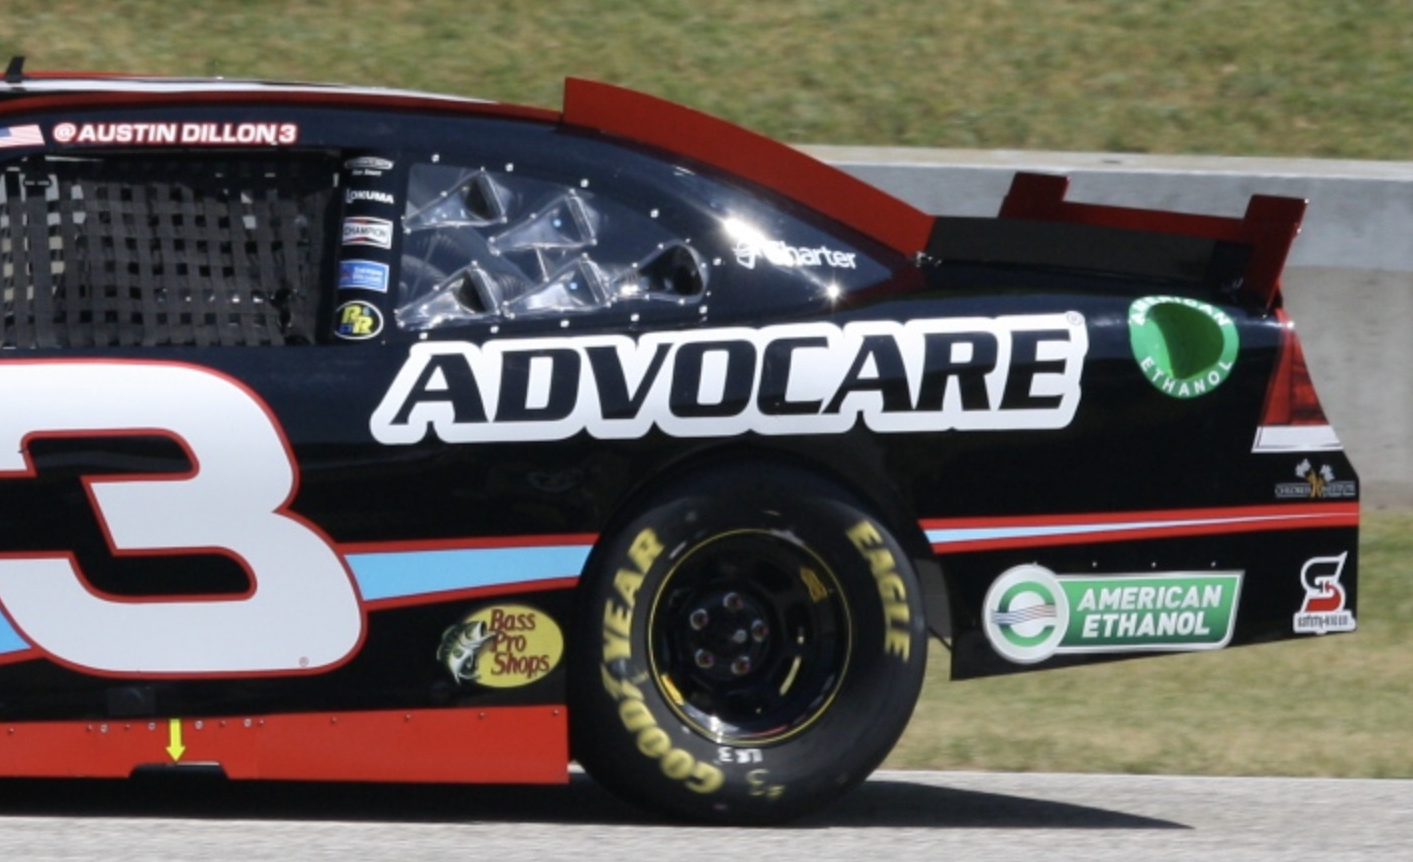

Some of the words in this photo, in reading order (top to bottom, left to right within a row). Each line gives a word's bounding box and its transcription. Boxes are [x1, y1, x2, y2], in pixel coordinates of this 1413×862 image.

[384, 325, 1076, 429] ADVOCARE
[1140, 357, 1232, 397] ETHANOL
[845, 520, 912, 662] EAGLE
[1076, 585, 1223, 612] AMERICAN
[489, 608, 536, 632] Bass
[1081, 611, 1211, 638] ETHANOL
[489, 630, 527, 653] Pro
[491, 652, 550, 679] Shops
